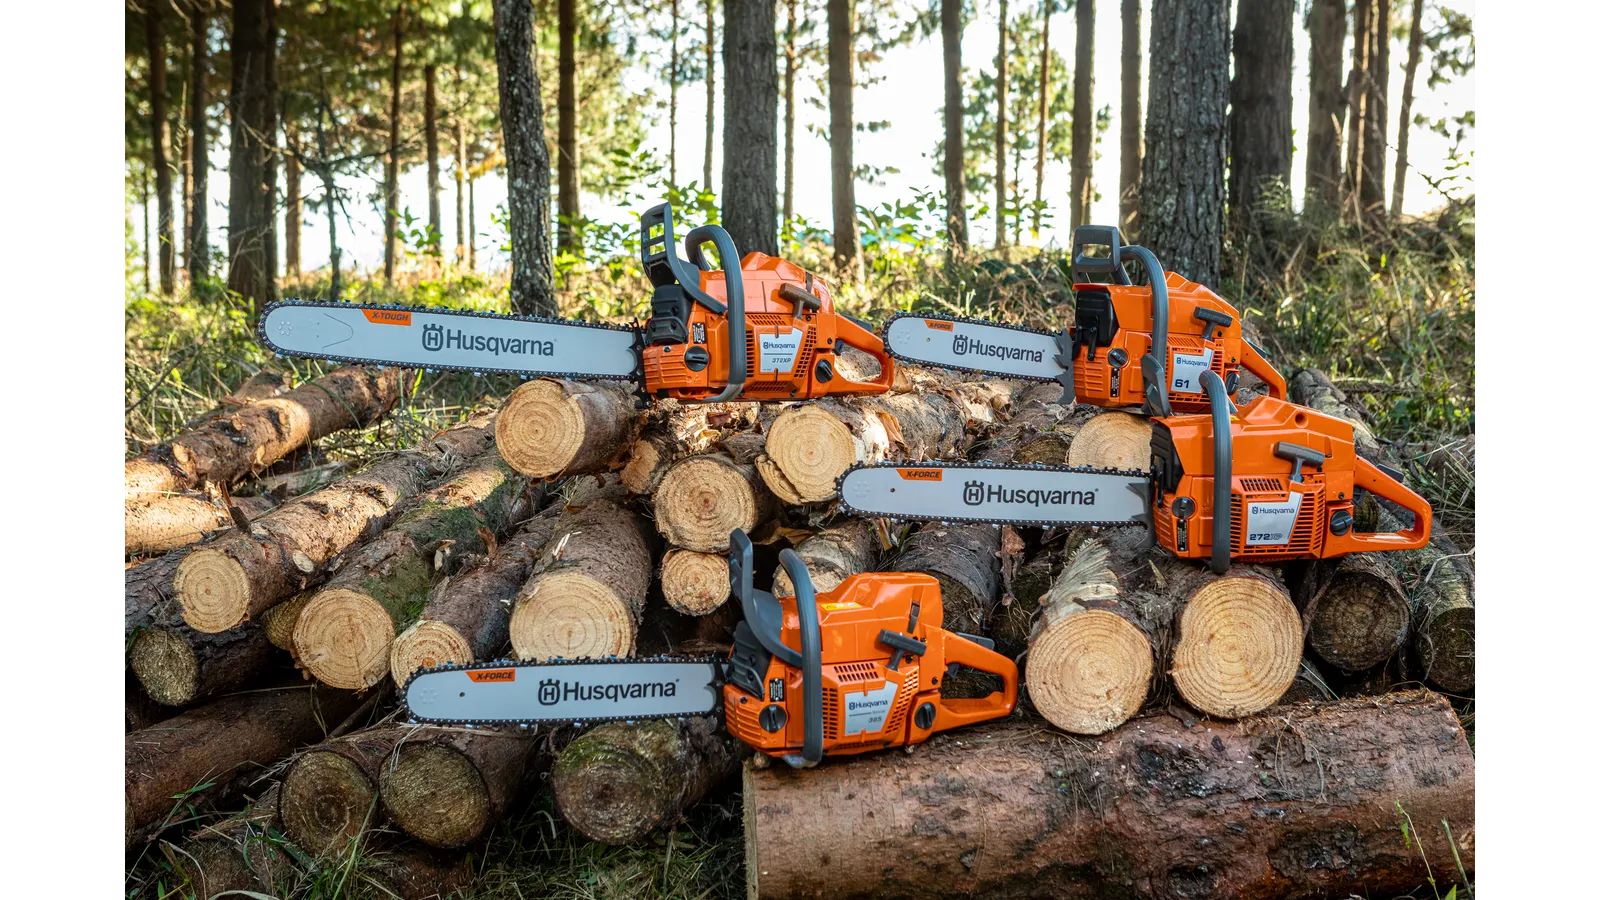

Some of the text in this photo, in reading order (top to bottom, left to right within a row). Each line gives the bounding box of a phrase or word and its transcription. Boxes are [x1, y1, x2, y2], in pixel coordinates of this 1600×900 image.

[371, 310, 409, 322] X-TOUGH
[929, 322, 952, 331] X-FORCE
[446, 329, 554, 357] Husqvarna
[969, 339, 1043, 363] Husqvarna
[1174, 379, 1190, 389] 61
[906, 471, 940, 479] X-FORCE
[988, 484, 1095, 507] Husqvarna
[475, 671, 513, 681] X-FORCE
[564, 681, 676, 702] Husqvarna
[855, 700, 888, 708] Husqvarna
